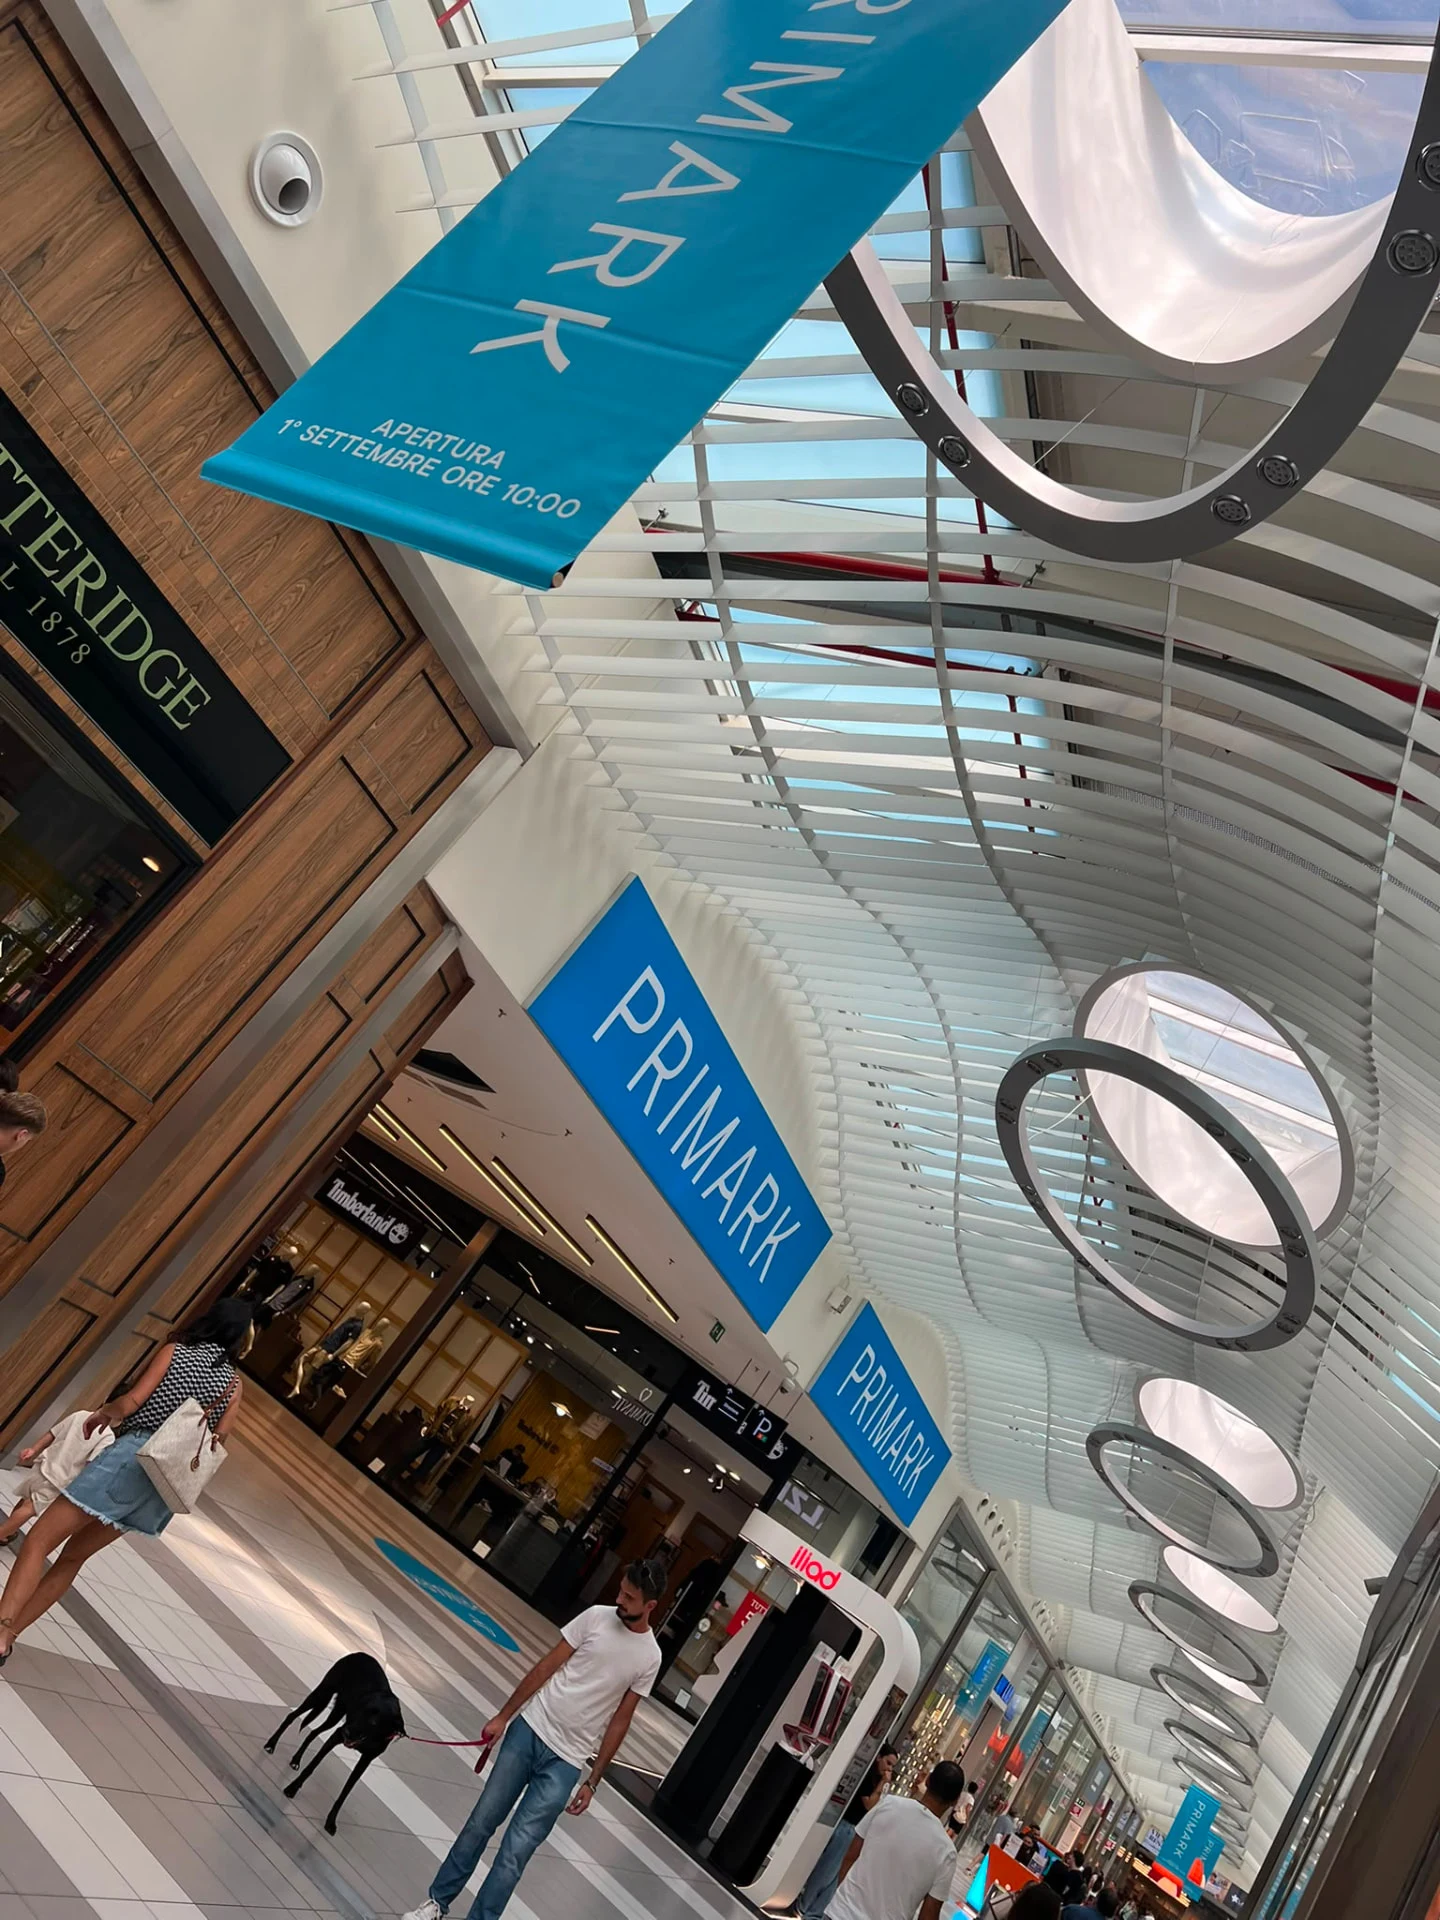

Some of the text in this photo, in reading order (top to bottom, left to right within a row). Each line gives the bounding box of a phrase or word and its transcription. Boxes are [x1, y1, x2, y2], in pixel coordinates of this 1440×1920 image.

[470, 0, 911, 373] IMARK
[299, 424, 442, 478] SETTEMBRE
[441, 465, 502, 496] ORE
[501, 483, 582, 519] 10:00
[371, 418, 506, 469] APERTURA
[26, 595, 91, 665] 1878
[592, 964, 801, 1284] PRIMARK
[326, 1178, 397, 1235] Timberland
[836, 1343, 935, 1498] PRIMARK
[789, 1545, 842, 1590] iliad
[1173, 1800, 1206, 1859] PRIMARK
